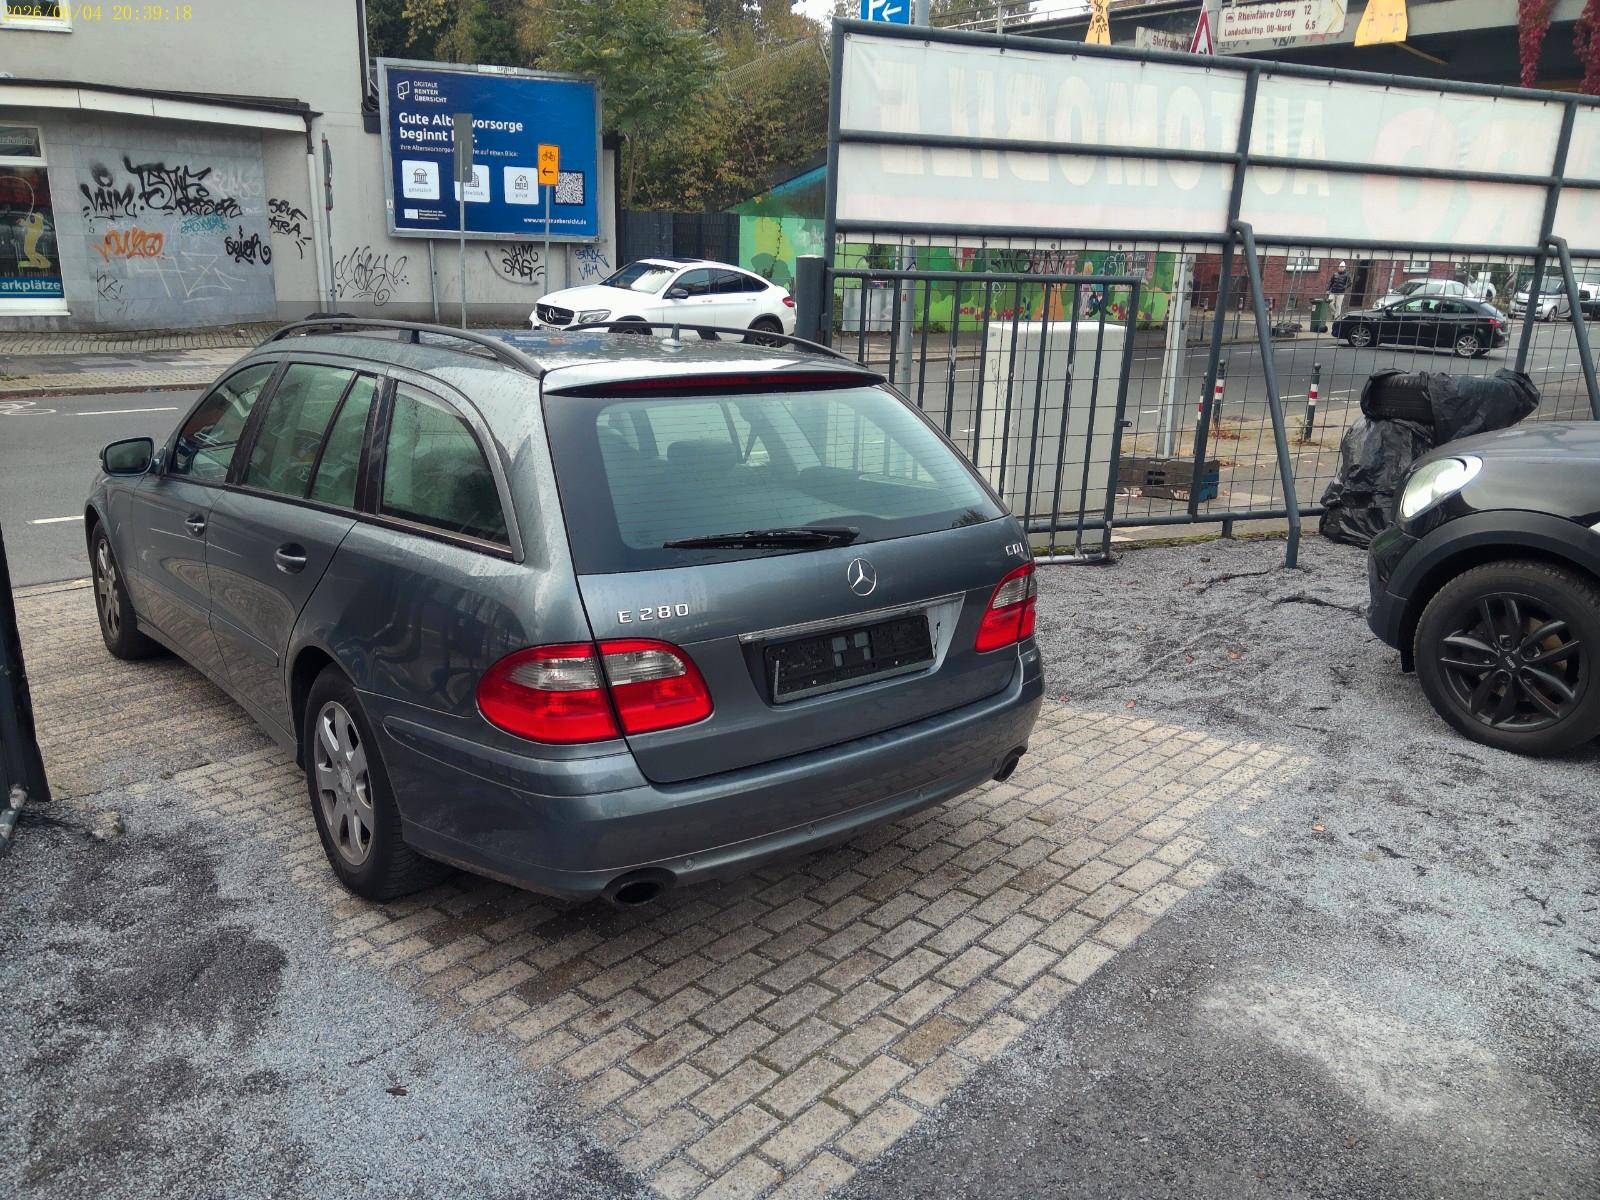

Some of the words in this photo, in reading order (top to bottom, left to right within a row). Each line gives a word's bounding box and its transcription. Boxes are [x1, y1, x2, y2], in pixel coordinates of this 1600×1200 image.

[1238, 8, 1275, 21] Rheinfähre
[1276, 8, 1296, 18] Orsoy
[1304, 5, 1312, 16] 12
[413, 80, 438, 89] DIGITALE
[414, 88, 439, 96] RENTEN
[414, 95, 447, 103] ÜBERSICHT
[398, 112, 430, 125] Gute
[432, 113, 524, 134] Altvorsorge
[399, 126, 449, 142] beginnt
[0, 279, 61, 292] arkplätze
[1005, 542, 1024, 556] CDI
[617, 610, 633, 624] E
[639, 603, 689, 621] 280
